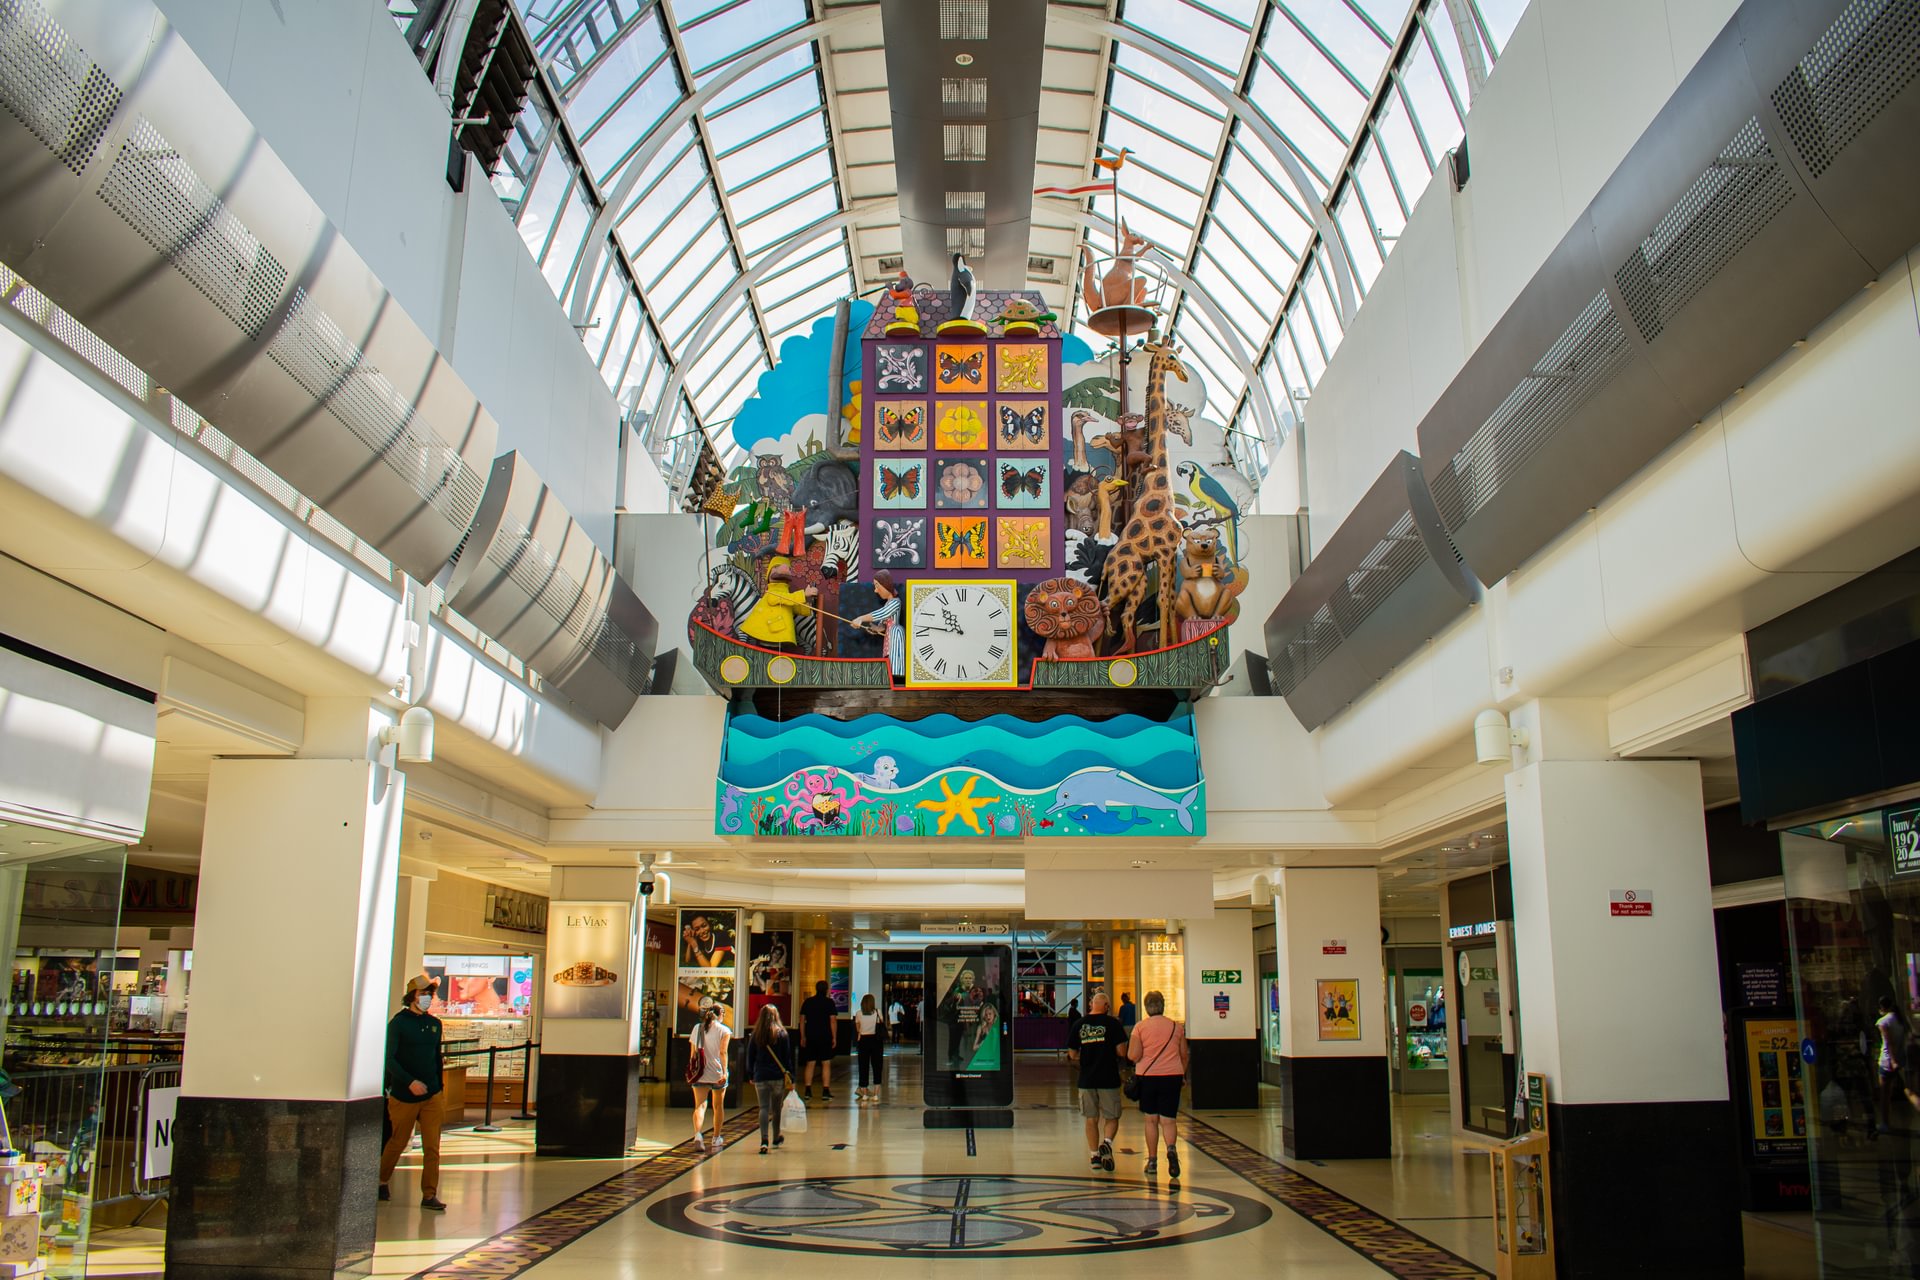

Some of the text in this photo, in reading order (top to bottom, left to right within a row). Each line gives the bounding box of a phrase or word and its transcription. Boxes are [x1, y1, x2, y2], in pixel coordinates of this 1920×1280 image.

[1893, 819, 1910, 832] hmv
[1895, 833, 1906, 847] 19
[1897, 847, 1908, 861] 20
[1449, 922, 1496, 939] ERNEST JONES
[1147, 942, 1177, 952] HERA
[155, 1119, 176, 1148] N
[1779, 1180, 1810, 1198] hmv
